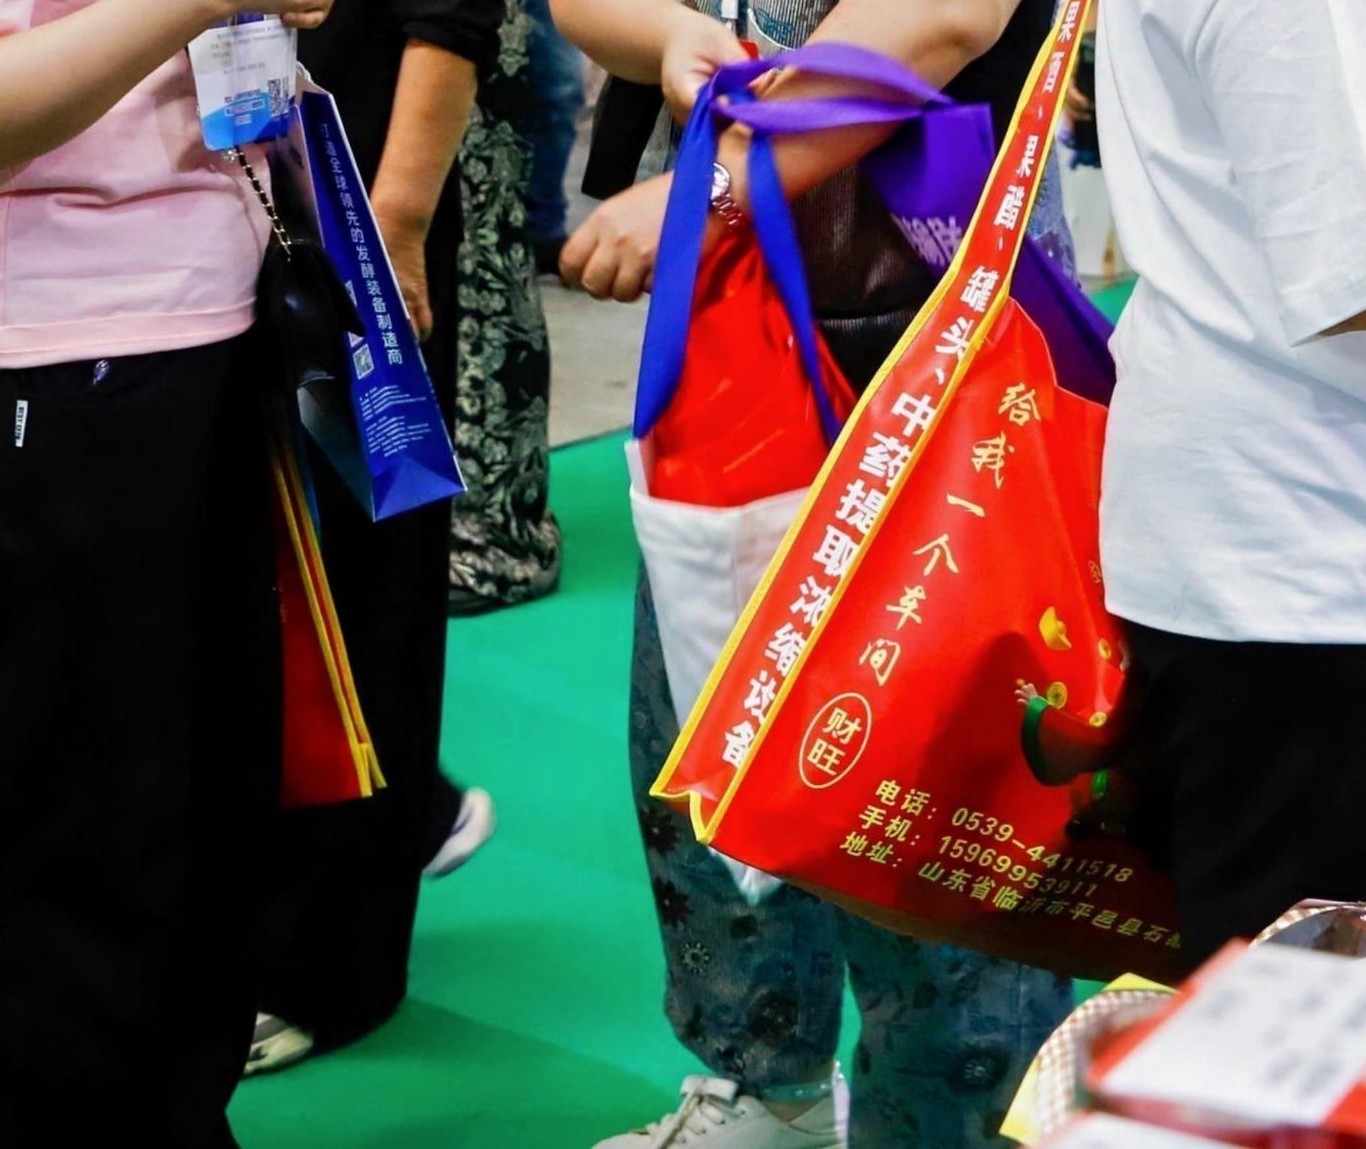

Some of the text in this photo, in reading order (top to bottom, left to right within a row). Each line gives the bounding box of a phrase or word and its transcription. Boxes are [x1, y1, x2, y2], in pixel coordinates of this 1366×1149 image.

[859, 383, 1041, 686] 给我一个车间
[807, 707, 862, 777] 财旺
[939, 835, 1098, 898] 15969953911
[952, 807, 1134, 882] 0539-4411518
